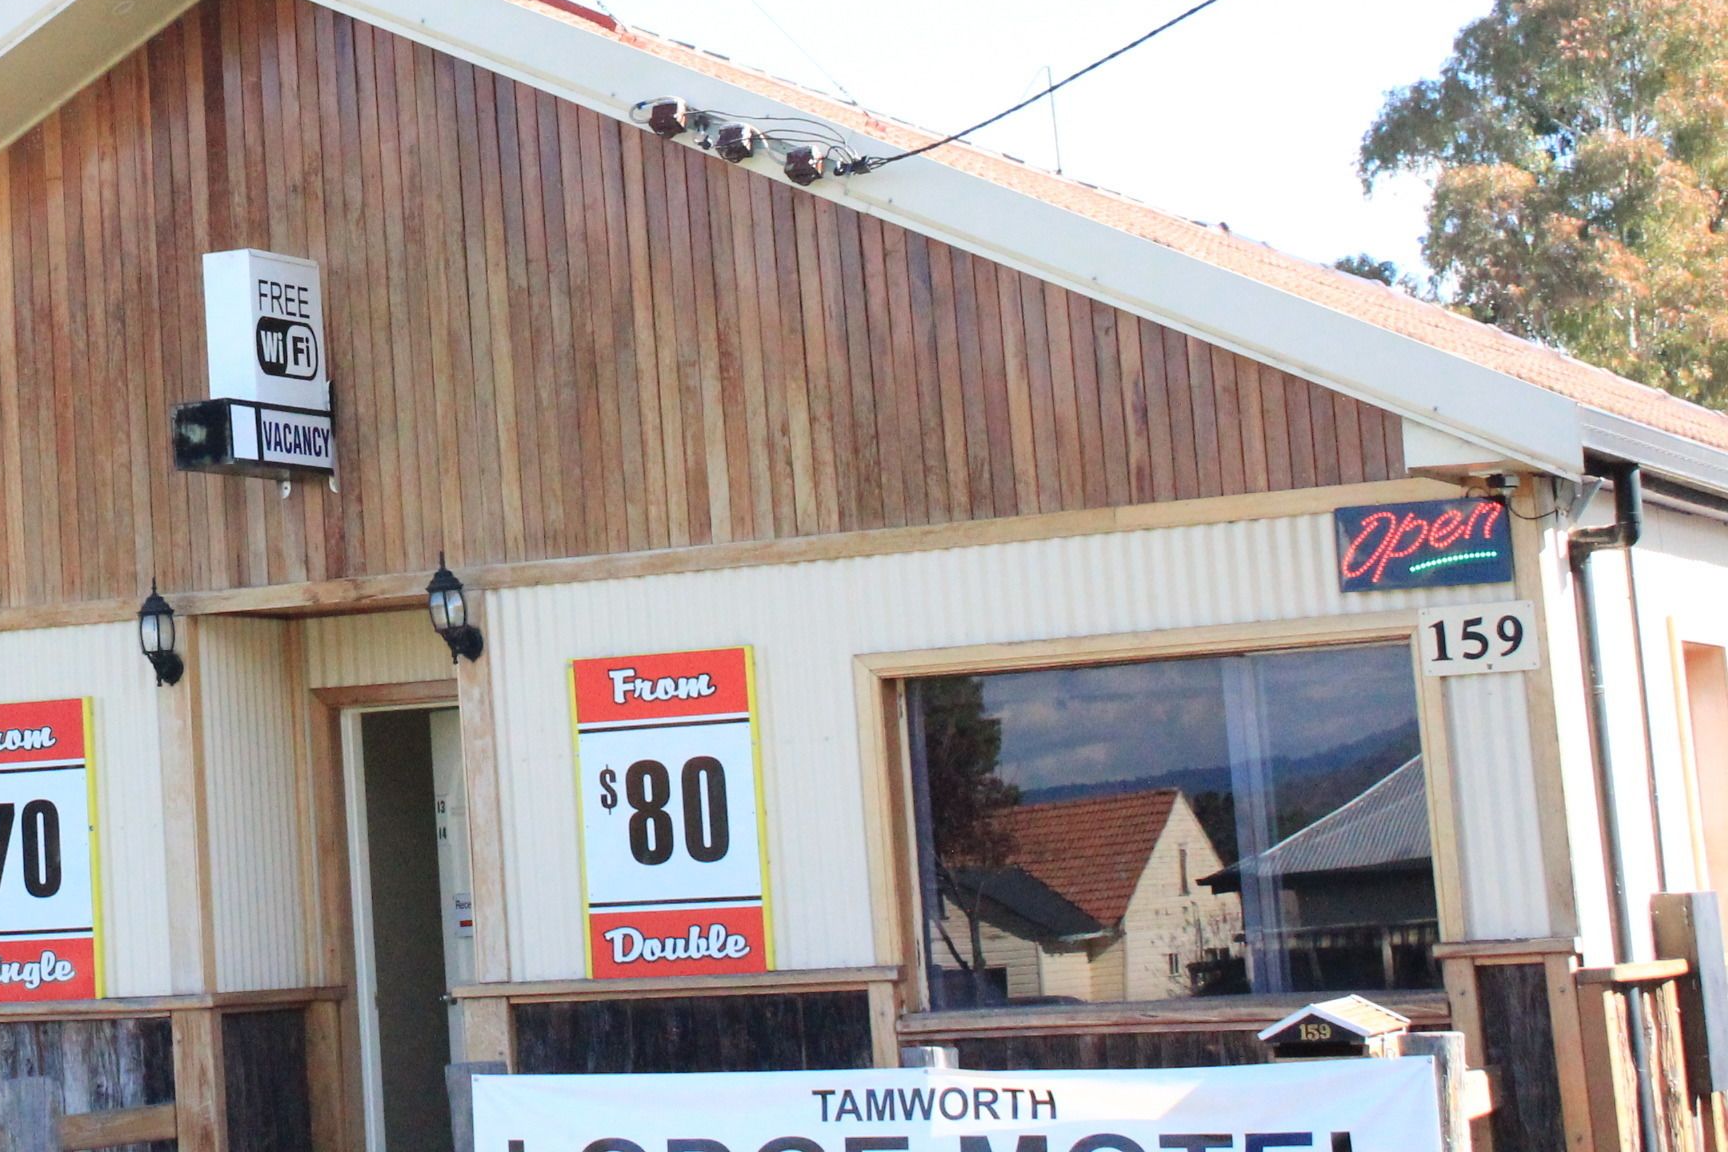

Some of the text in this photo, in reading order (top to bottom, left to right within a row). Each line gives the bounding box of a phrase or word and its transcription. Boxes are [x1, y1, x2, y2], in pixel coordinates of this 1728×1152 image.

[258, 279, 310, 319] FREE
[263, 420, 330, 458] VACANCY
[1342, 501, 1503, 583] Open
[1428, 615, 1523, 662] 159
[608, 668, 716, 705] From
[437, 800, 446, 814] 13
[599, 755, 730, 866] $80
[438, 827, 447, 840] 14
[604, 923, 751, 964] Double
[1298, 1023, 1332, 1041] 159
[811, 1086, 1057, 1123] TAMWORTH
